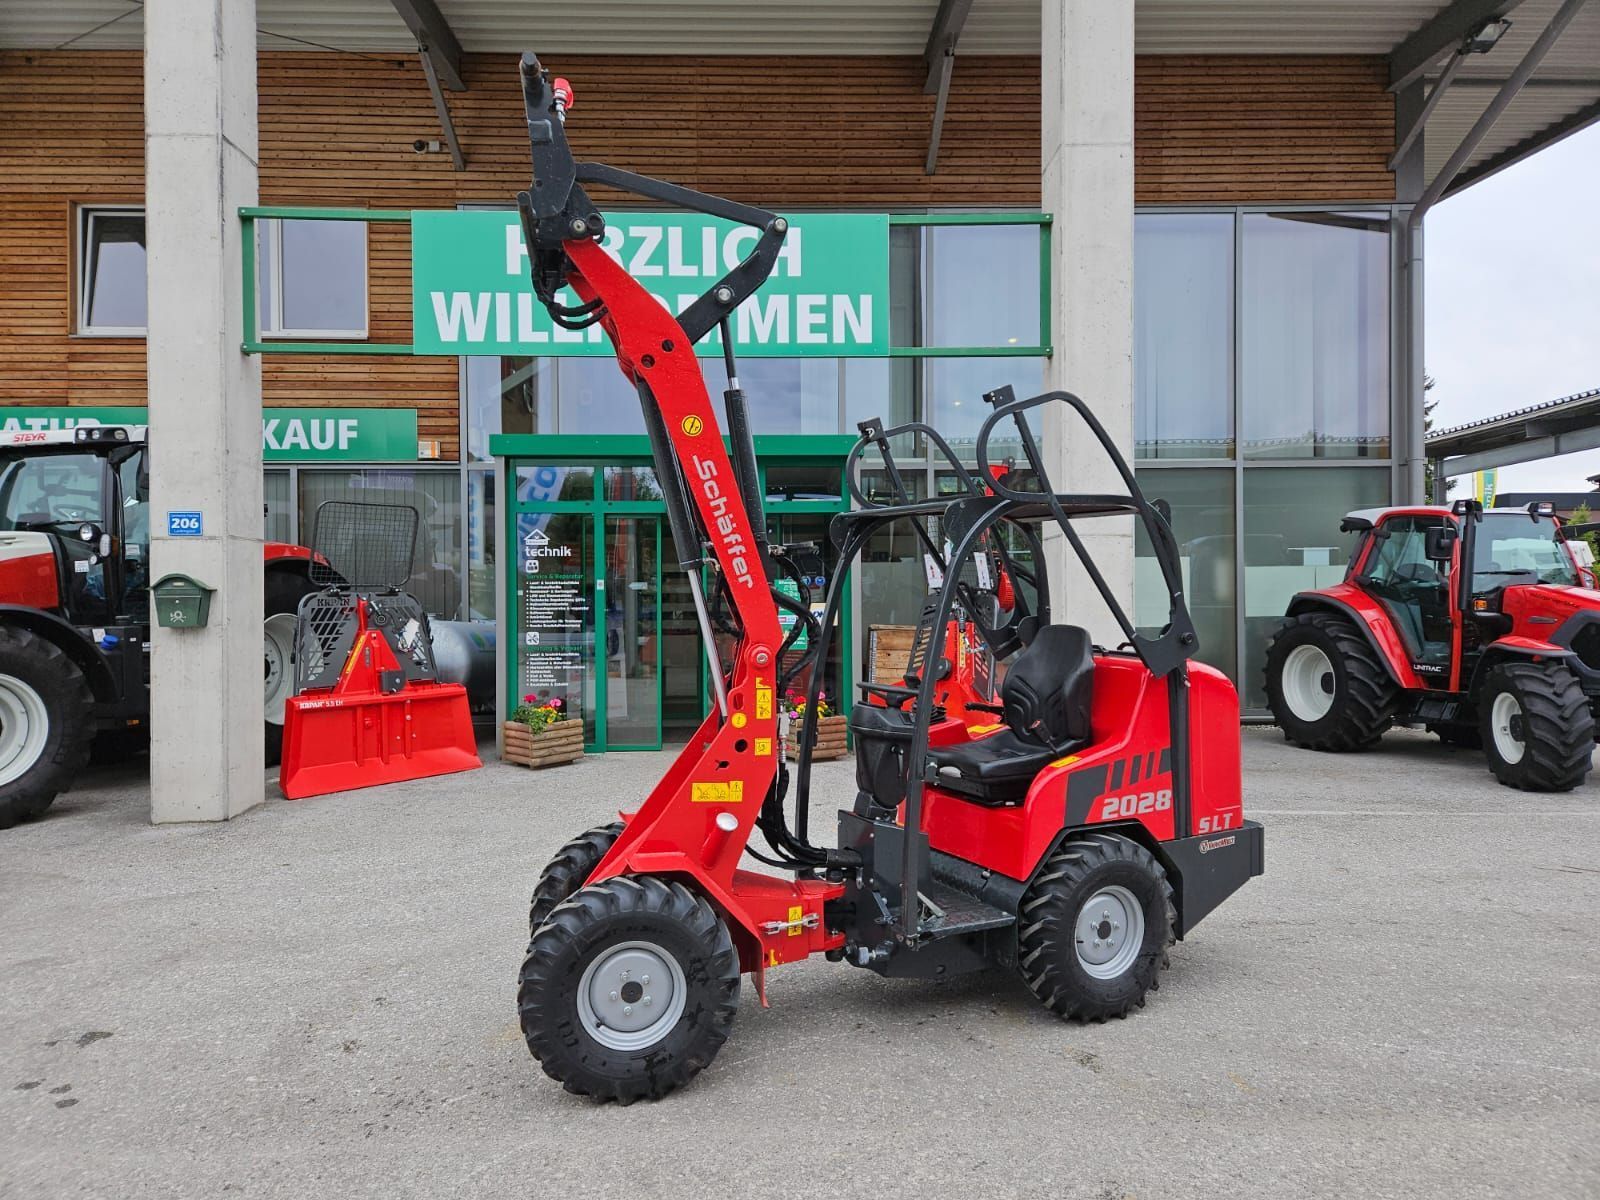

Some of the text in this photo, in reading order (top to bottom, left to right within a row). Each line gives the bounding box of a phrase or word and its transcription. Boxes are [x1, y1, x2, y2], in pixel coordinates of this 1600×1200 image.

[13, 433, 46, 442] STEYR
[171, 518, 199, 529] 206
[692, 454, 754, 589] Schäffer
[525, 545, 572, 557] technik
[1413, 664, 1442, 673] UNITRAC
[1101, 789, 1172, 821] 2028
[1198, 813, 1233, 834] SLT
